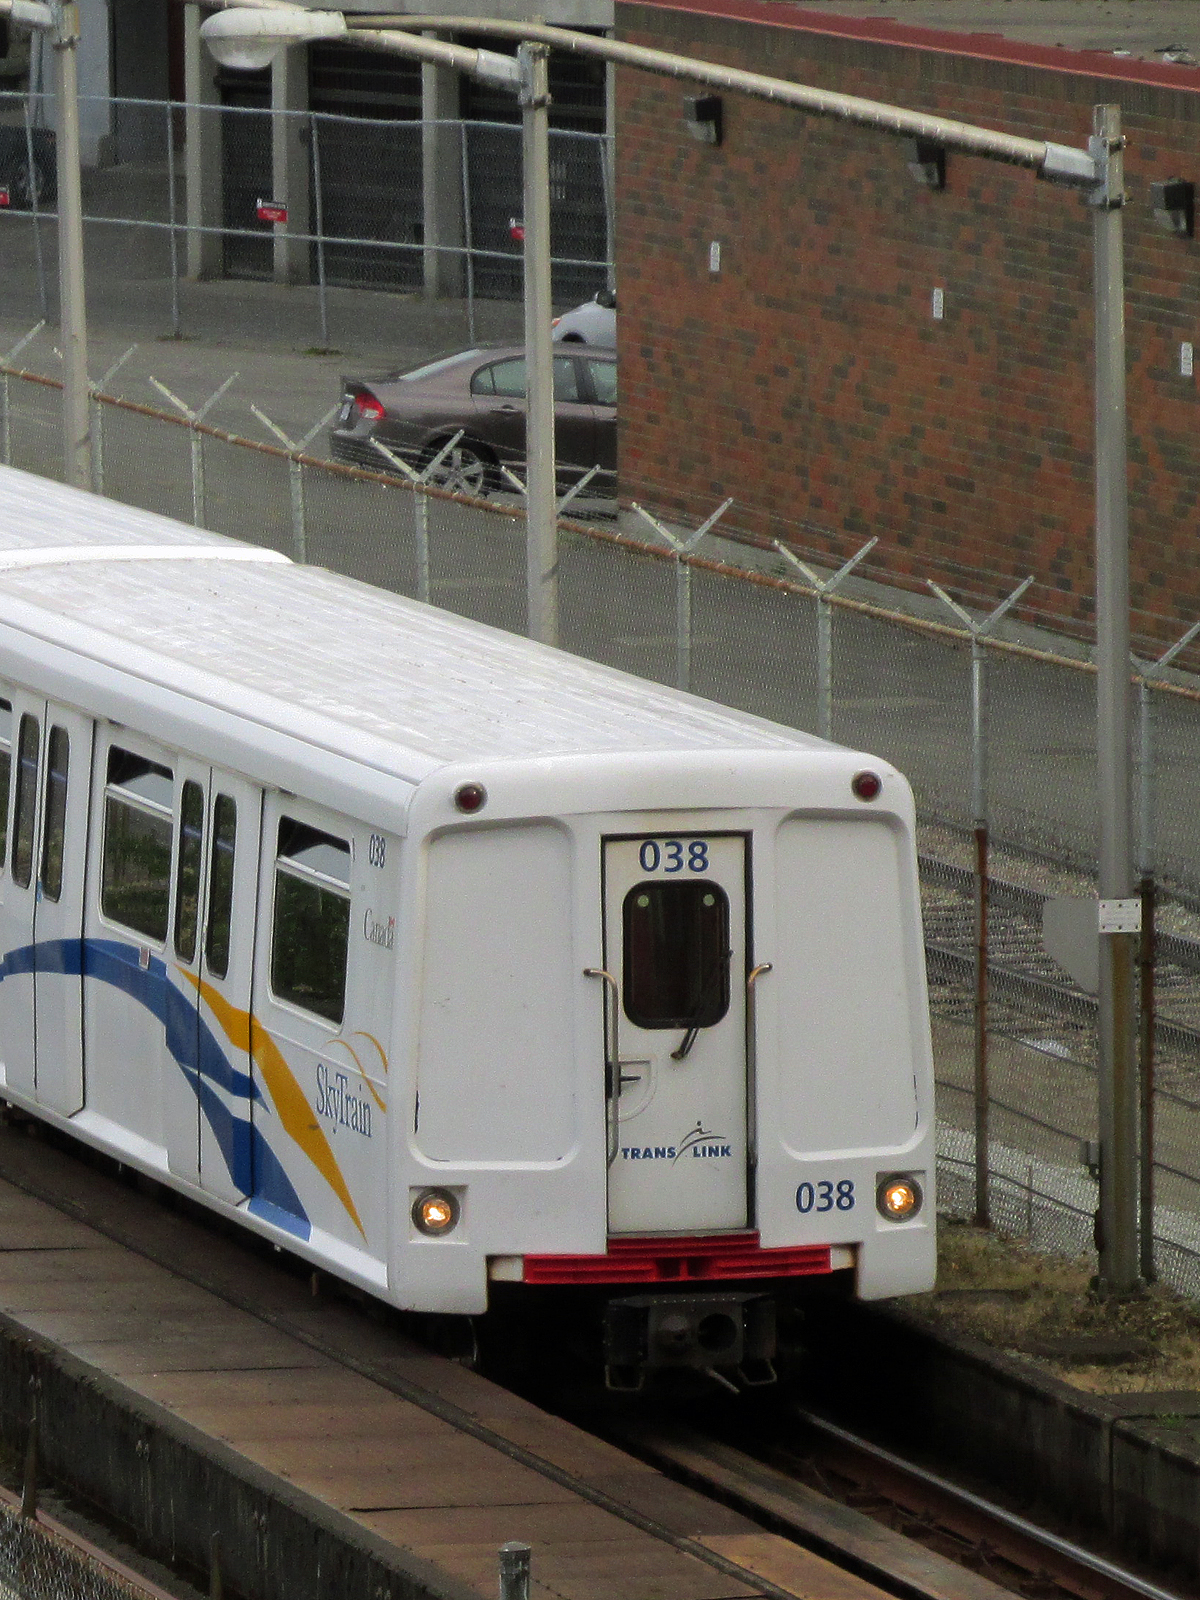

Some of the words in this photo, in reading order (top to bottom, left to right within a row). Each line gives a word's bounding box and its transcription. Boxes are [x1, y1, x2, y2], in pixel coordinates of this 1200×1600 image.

[369, 833, 385, 869] 038
[639, 840, 709, 873] 038
[363, 907, 395, 950] Canada
[316, 1063, 373, 1138] SkyTrain
[621, 1146, 677, 1160] TRANS
[693, 1145, 732, 1158] LINK
[795, 1179, 856, 1214] 038
